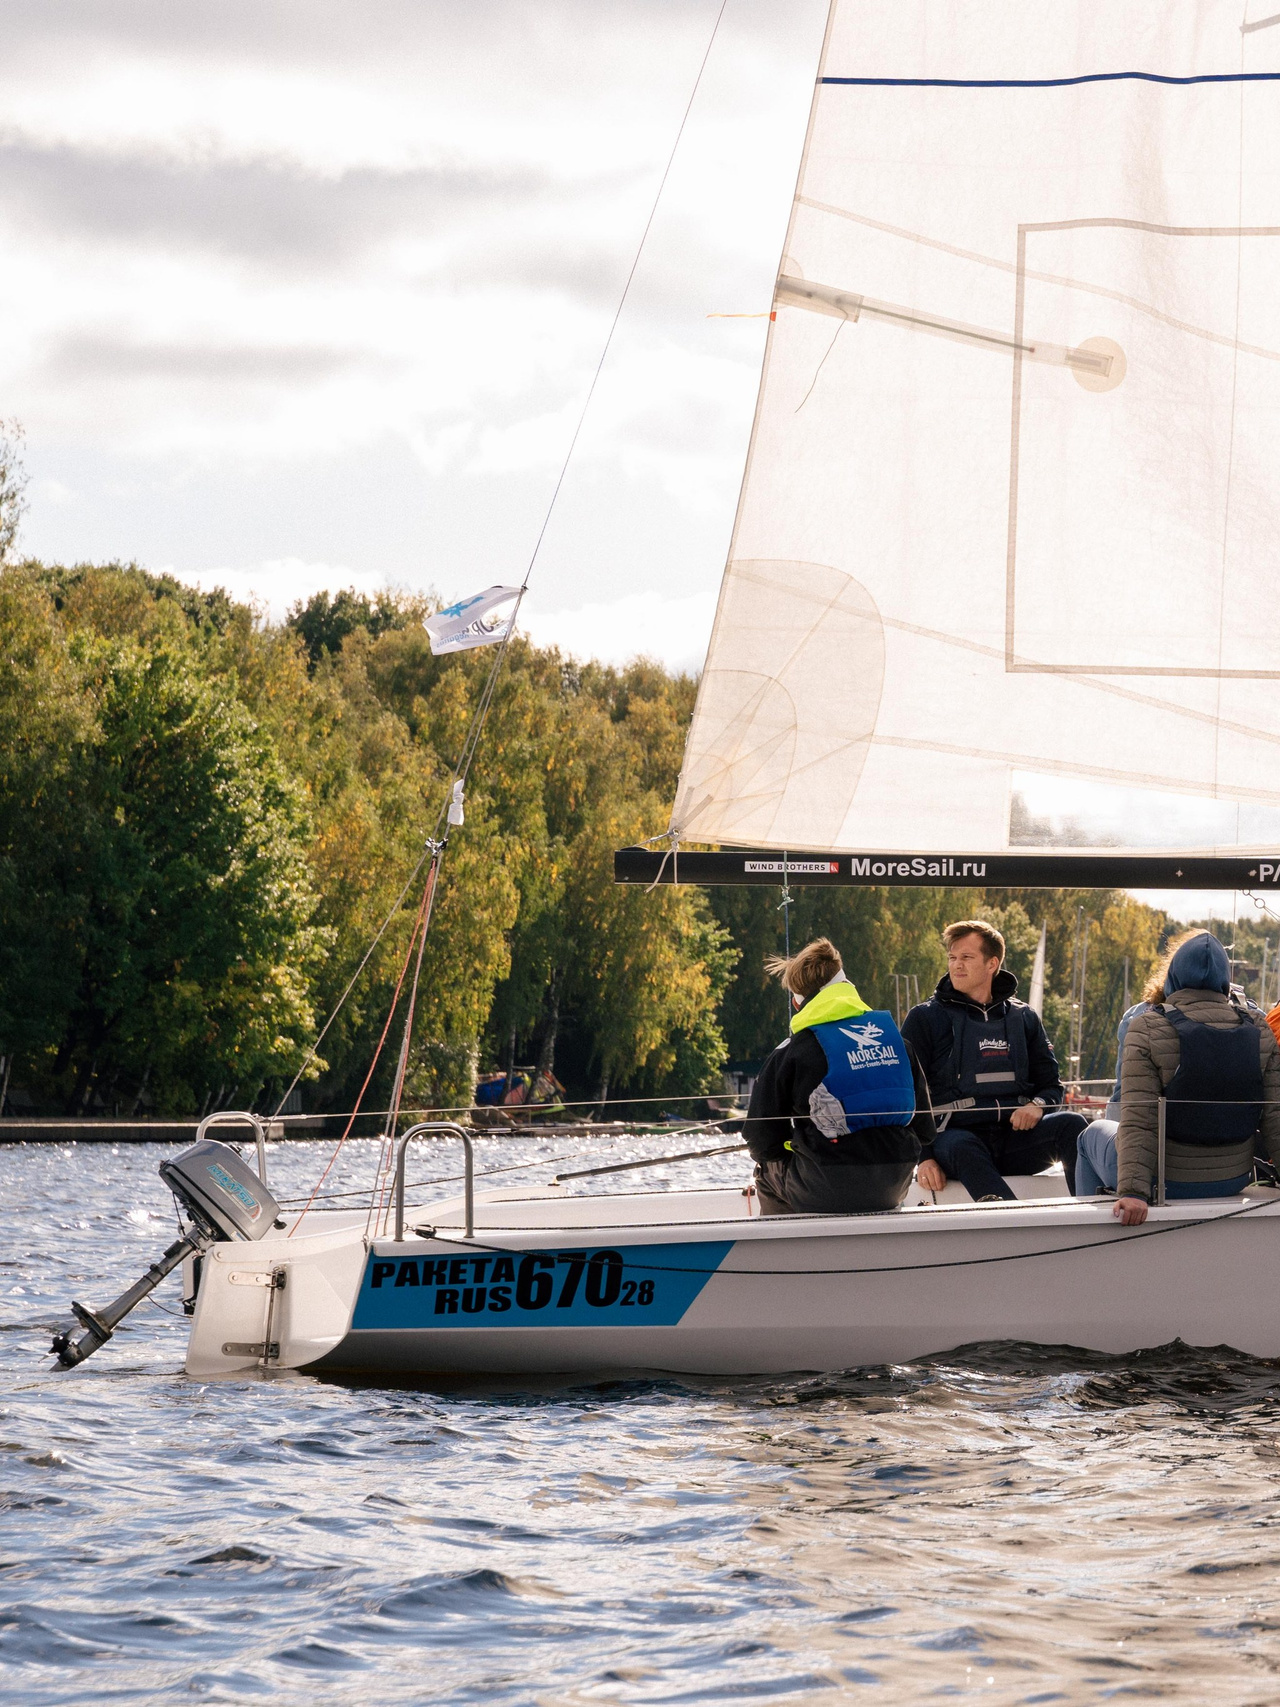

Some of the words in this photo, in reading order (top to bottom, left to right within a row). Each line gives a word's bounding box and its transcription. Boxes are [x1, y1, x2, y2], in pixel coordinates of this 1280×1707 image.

[749, 863, 775, 871] WIND
[777, 863, 826, 871] BROTHERS
[851, 858, 987, 877] MoreSail.ru
[514, 1250, 624, 1311] 670
[619, 1279, 655, 1307] 28
[434, 1286, 512, 1315] RUS
